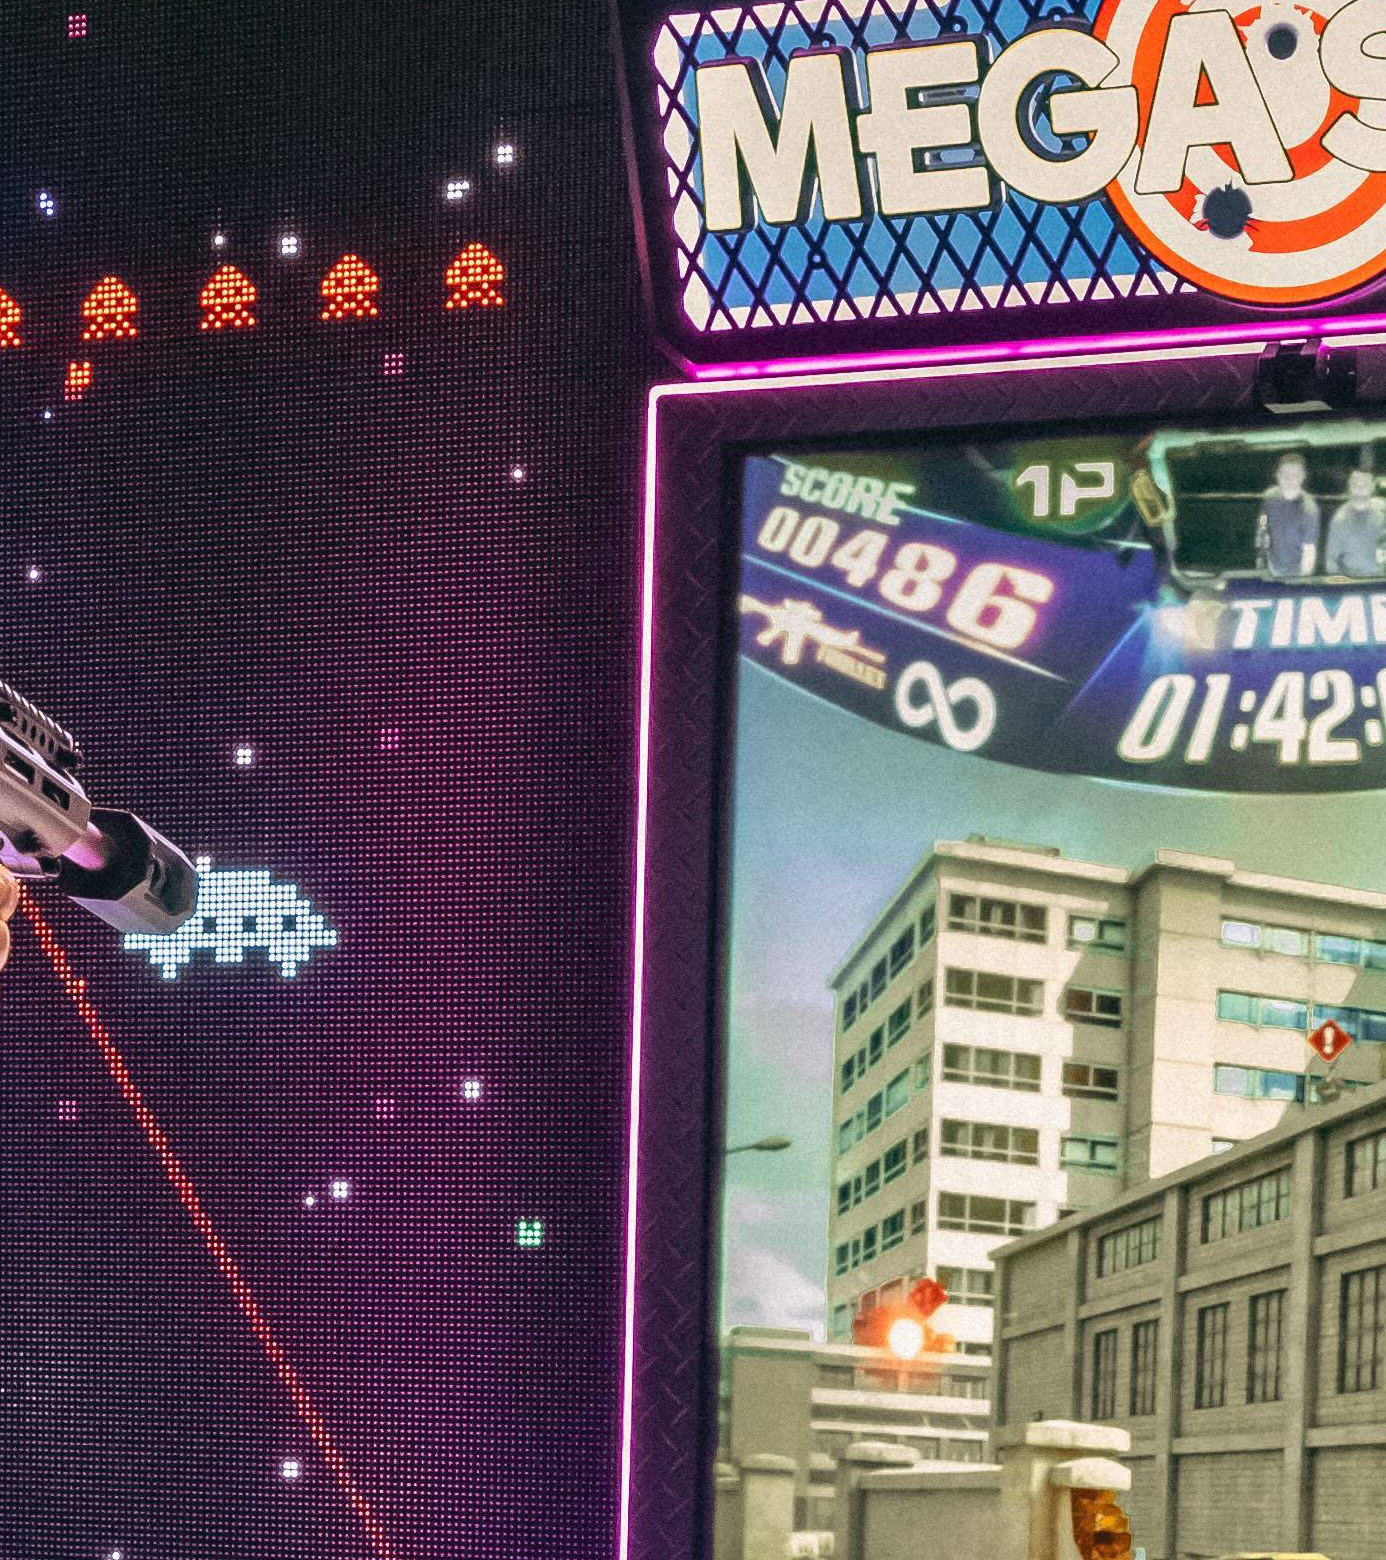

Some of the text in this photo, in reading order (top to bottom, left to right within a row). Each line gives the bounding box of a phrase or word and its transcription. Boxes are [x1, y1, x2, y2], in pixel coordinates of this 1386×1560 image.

[780, 464, 915, 526] SCORE
[1016, 462, 1114, 516] 1P
[756, 506, 1054, 649] 00486
